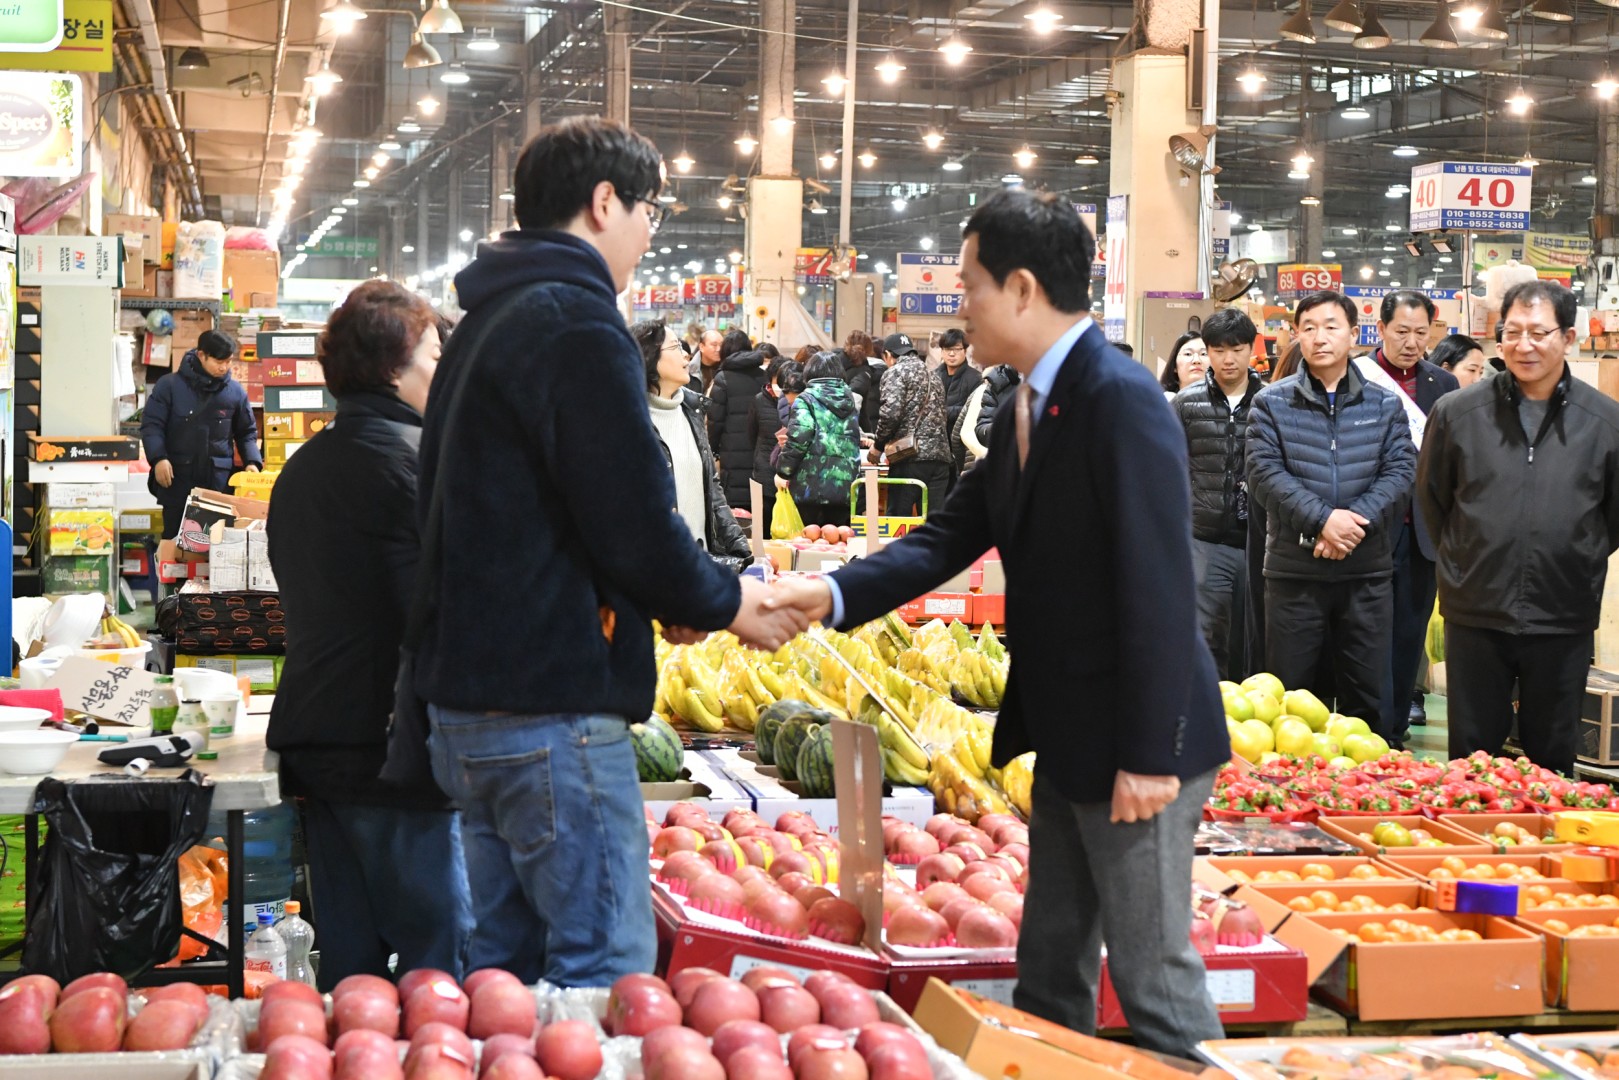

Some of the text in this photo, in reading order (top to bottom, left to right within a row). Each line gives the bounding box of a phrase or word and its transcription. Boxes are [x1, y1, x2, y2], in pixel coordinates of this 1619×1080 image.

[1416, 179, 1436, 208] 40
[1457, 178, 1515, 208] 40
[1446, 210, 1525, 220] 010-8552-6838
[1446, 220, 1525, 229] 010-9552-6838
[1107, 238, 1125, 304] 44
[705, 280, 730, 294] 87
